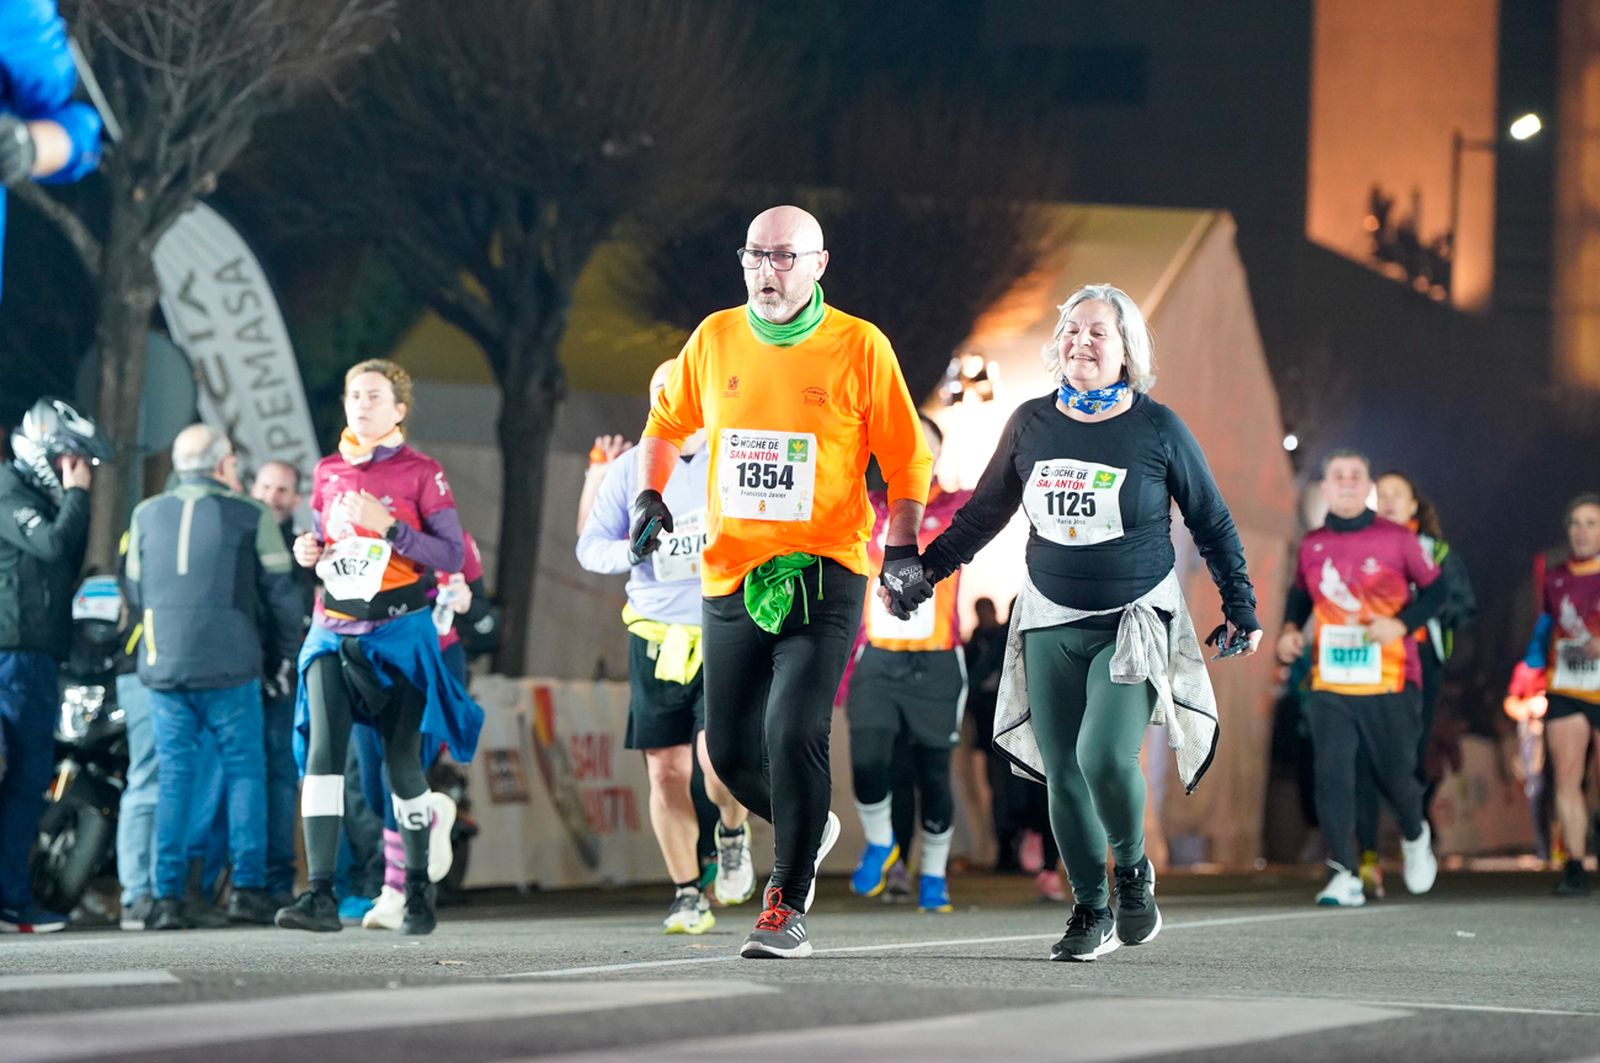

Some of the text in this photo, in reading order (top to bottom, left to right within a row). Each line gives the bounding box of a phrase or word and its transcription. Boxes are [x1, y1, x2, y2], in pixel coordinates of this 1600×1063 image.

[740, 440, 766, 450] NOCHE
[767, 441, 780, 450] DE
[729, 450, 747, 460] SAN
[747, 449, 779, 462] ANTÓN
[736, 462, 794, 491] 1354
[1050, 469, 1075, 478] OCHE
[1076, 471, 1089, 480] DE
[1044, 490, 1097, 517] 1125
